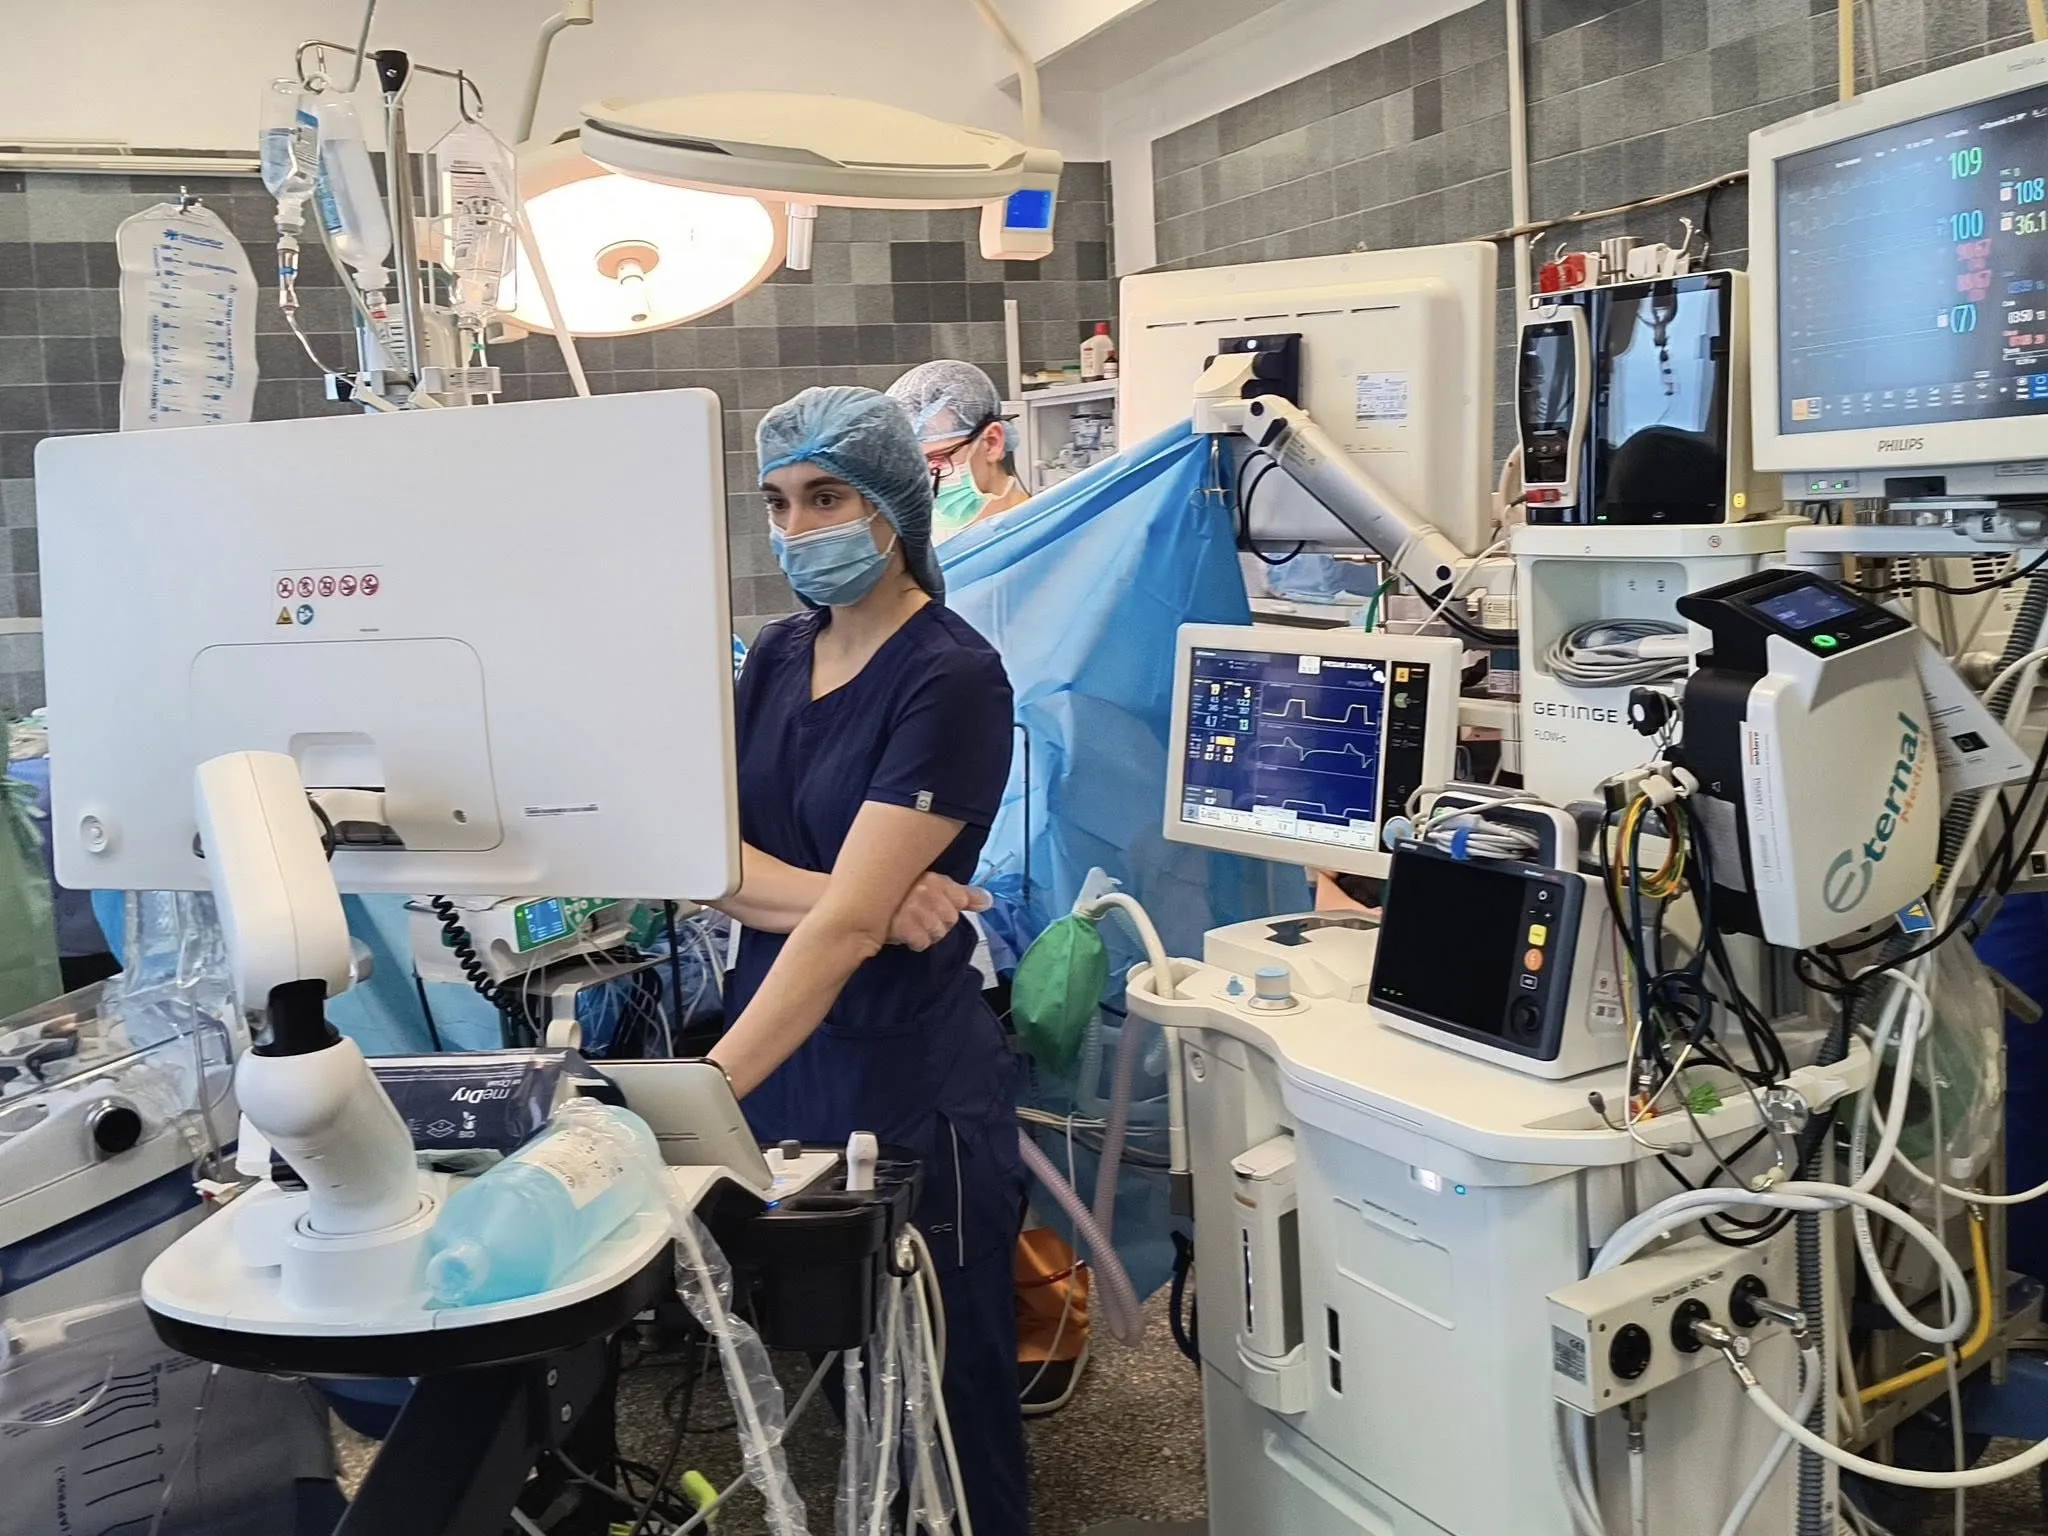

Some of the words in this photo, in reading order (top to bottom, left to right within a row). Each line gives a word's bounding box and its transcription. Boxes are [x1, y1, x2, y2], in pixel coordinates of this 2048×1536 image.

[1949, 147, 1982, 180] 109
[2014, 177, 2045, 205] 108
[1950, 210, 1984, 241] 100
[2015, 210, 2048, 236] 36.1
[1950, 304, 1977, 333] (7)
[1877, 437, 1924, 452] PHILIPS
[1533, 702, 1618, 723] GETINGE
[450, 1087, 511, 1104] meDry
